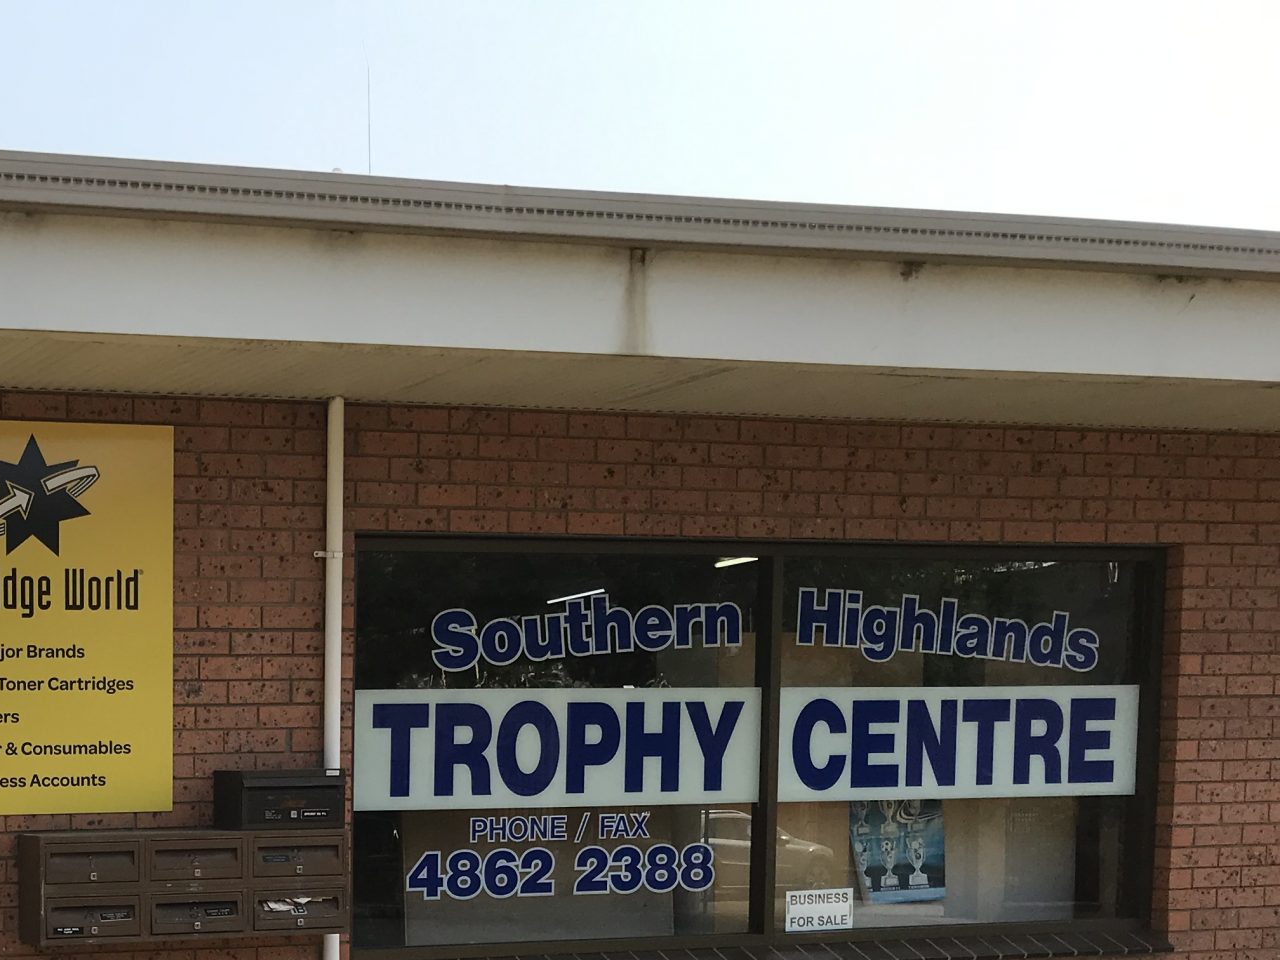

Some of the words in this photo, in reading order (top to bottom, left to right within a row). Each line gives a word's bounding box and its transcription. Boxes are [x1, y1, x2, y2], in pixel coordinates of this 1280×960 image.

[65, 568, 139, 611] World
[431, 594, 742, 672] Southern
[796, 586, 1099, 672] Highlands
[26, 644, 85, 659] Brands
[48, 677, 134, 694] Cartridges
[5, 742, 18, 756] &
[21, 740, 131, 755] Consumables
[372, 700, 745, 797] TROPHY
[792, 698, 1116, 791] CENTRE
[30, 773, 106, 787] Accounts
[470, 815, 567, 843] PHONE
[574, 812, 590, 842] /
[599, 812, 650, 839] FAX
[406, 847, 555, 900] 4862
[573, 843, 715, 895] 2388
[790, 892, 849, 906] BUSINESS
[790, 916, 814, 928] FOR
[817, 914, 848, 926] SALE
